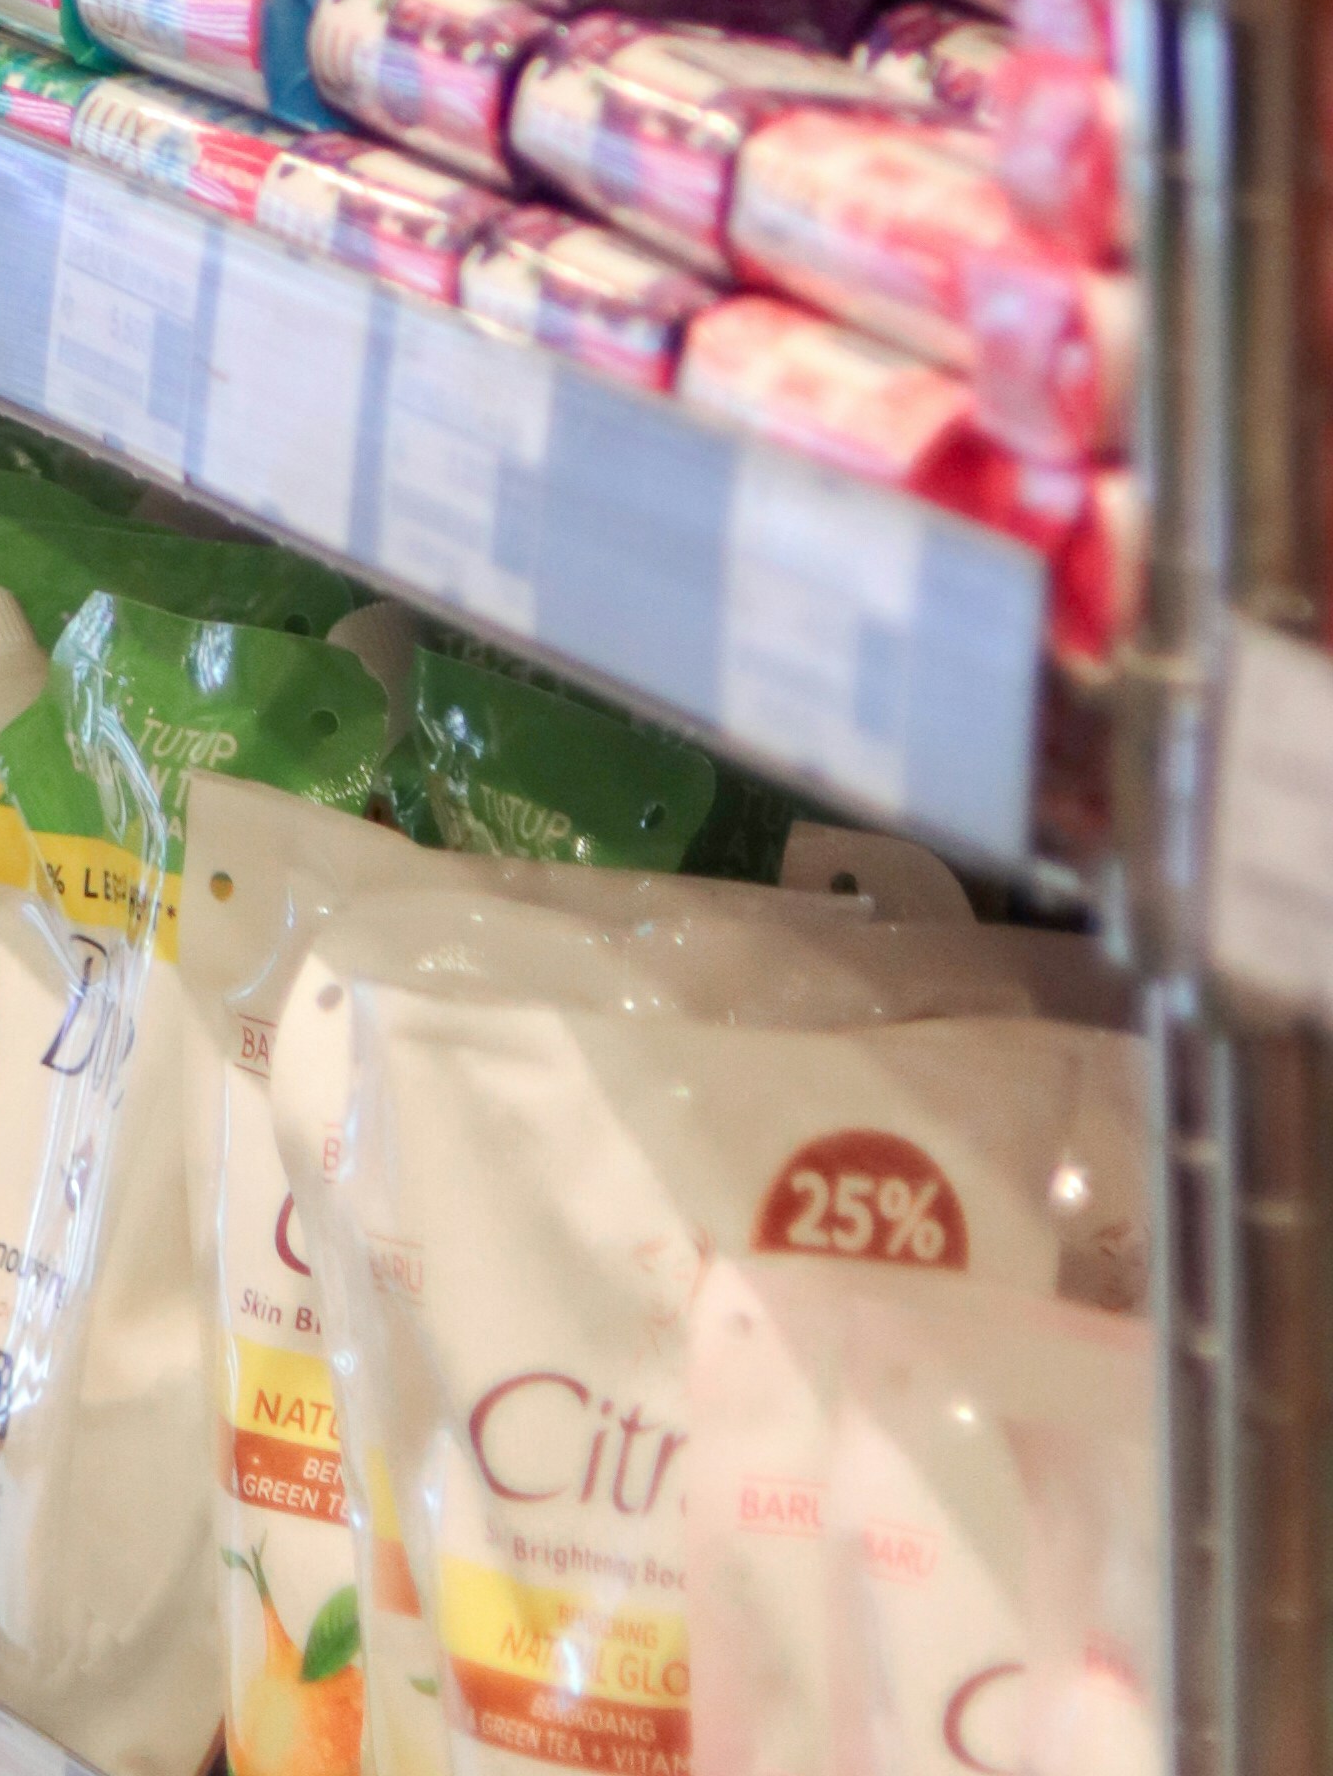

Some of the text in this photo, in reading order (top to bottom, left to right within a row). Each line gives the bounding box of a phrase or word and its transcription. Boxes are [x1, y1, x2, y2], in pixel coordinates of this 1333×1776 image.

[240, 1025, 270, 1067] BA
[785, 1171, 947, 1264] 25%
[240, 1288, 283, 1327] Skin
[468, 1370, 689, 1518] Citr
[243, 1473, 350, 1525] GREEN TE
[619, 1655, 690, 1697] GLO
[546, 1726, 584, 1762] TEA
